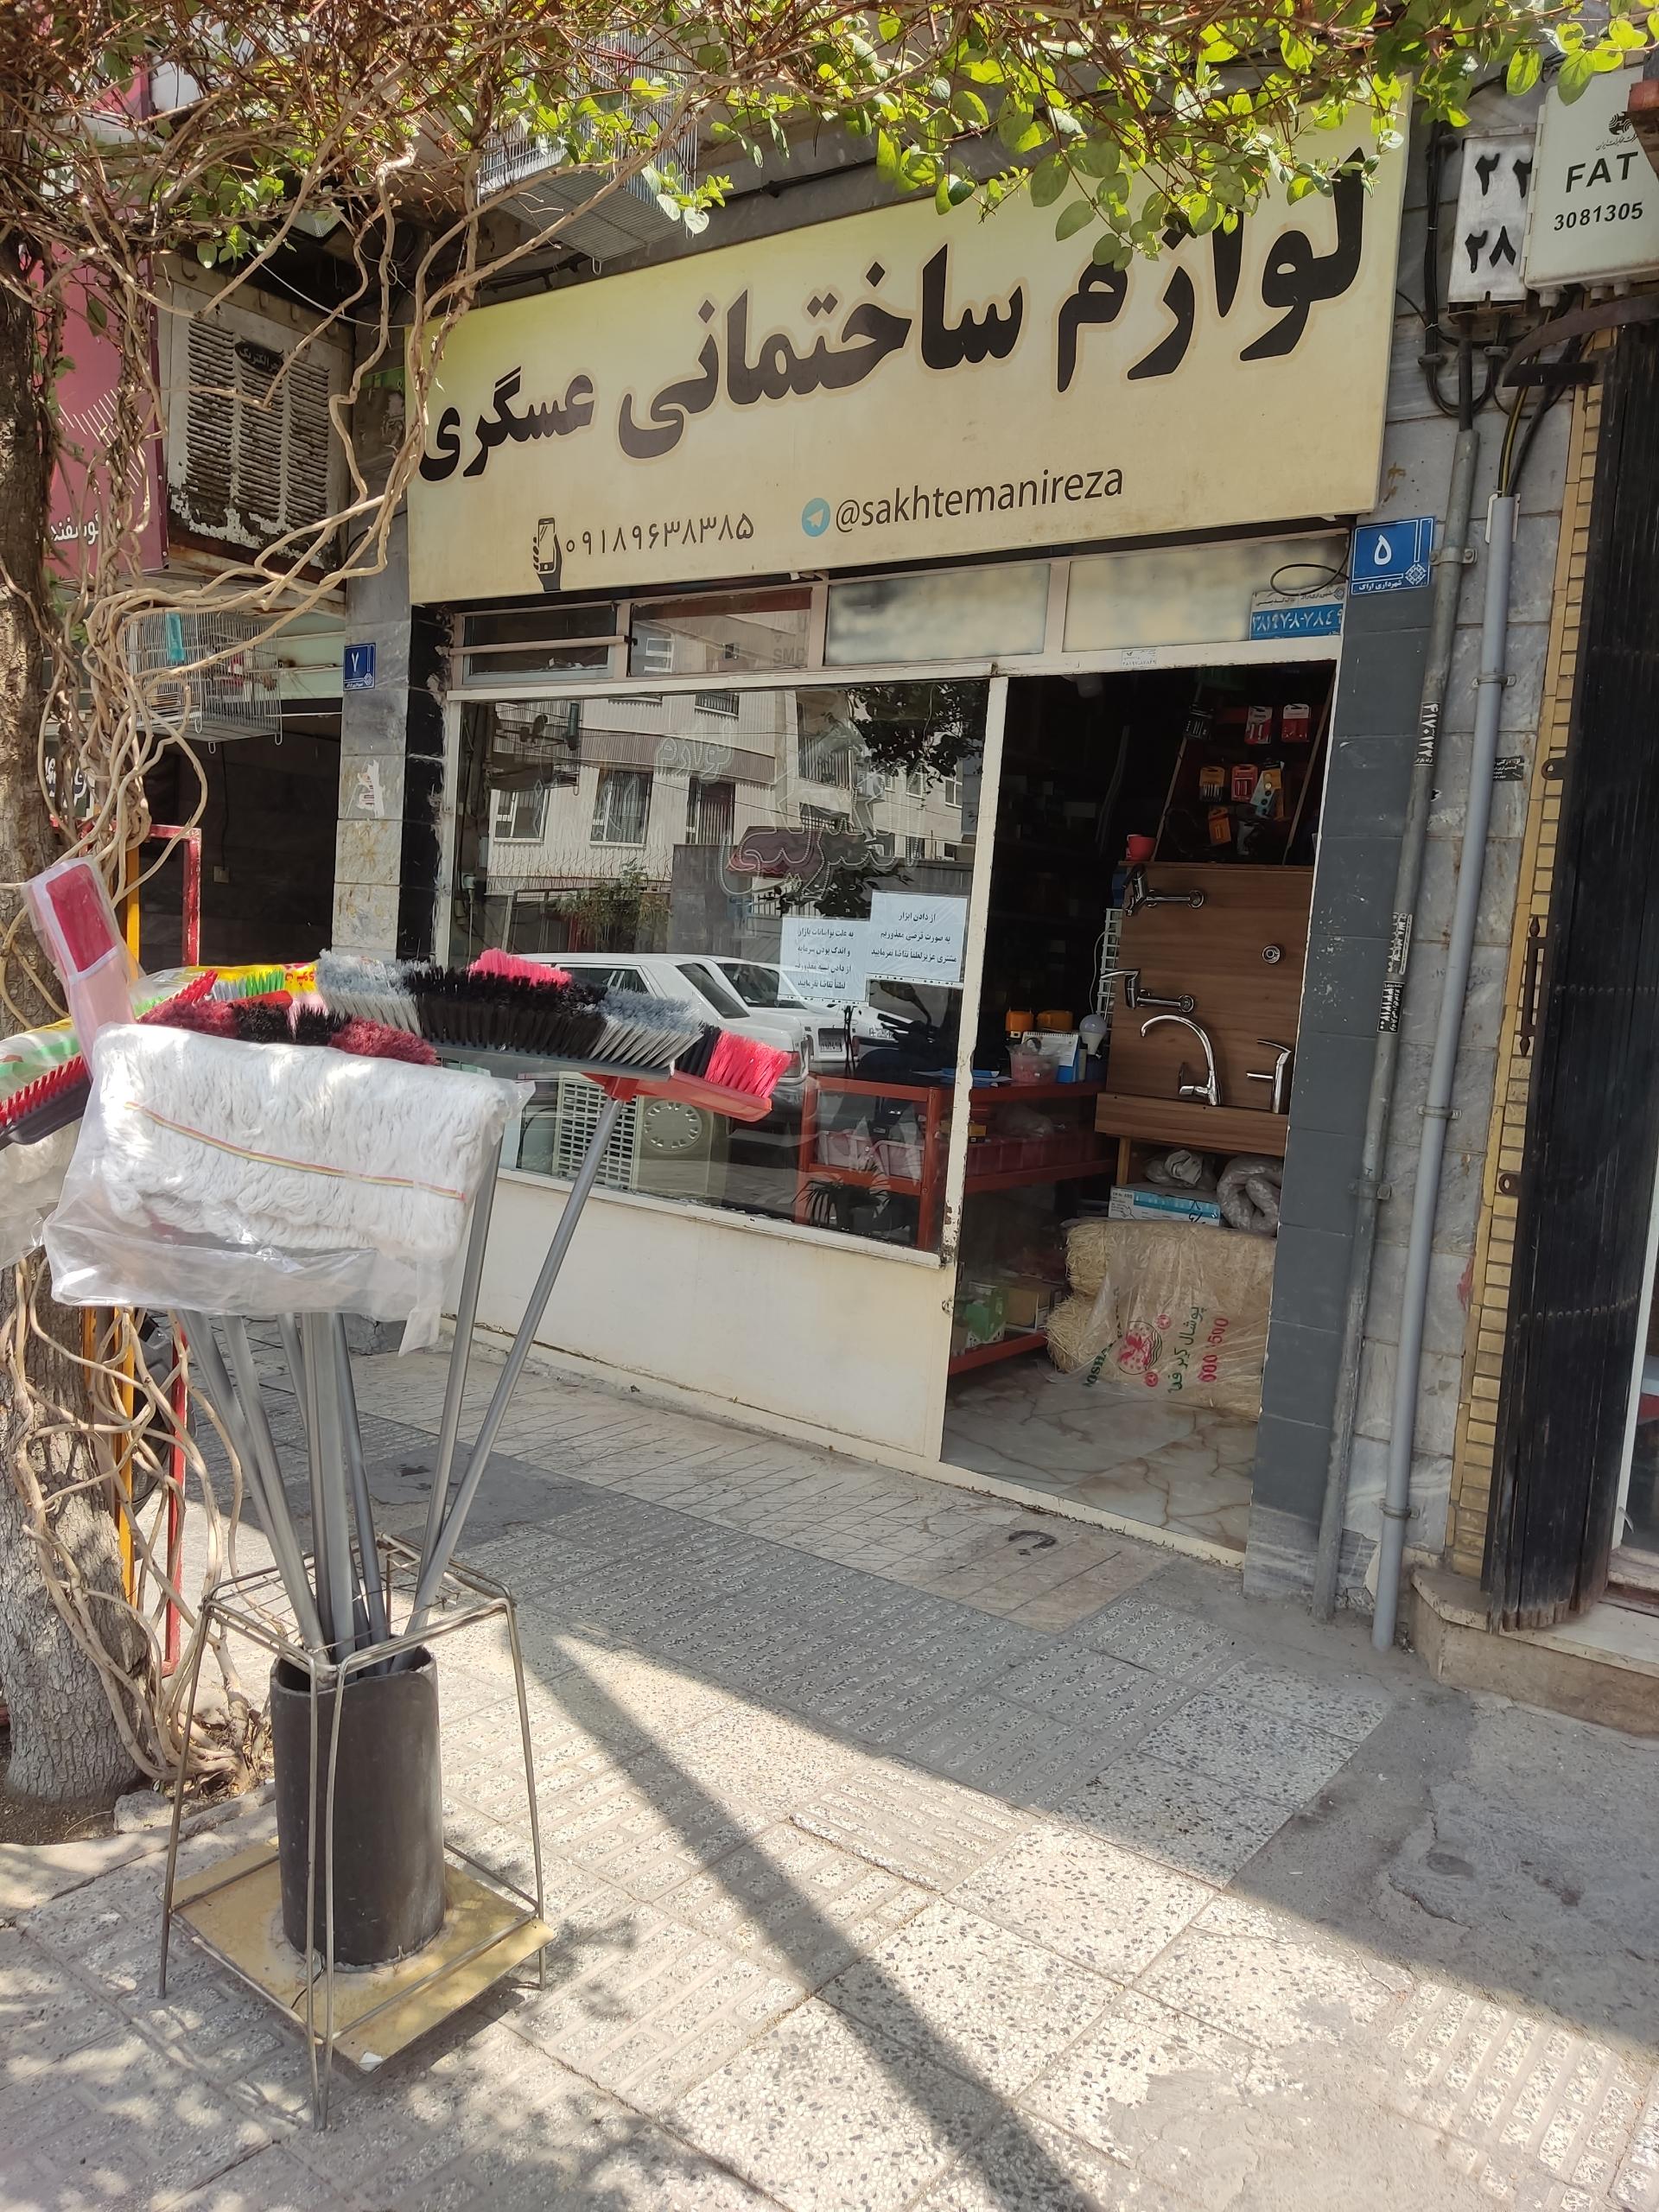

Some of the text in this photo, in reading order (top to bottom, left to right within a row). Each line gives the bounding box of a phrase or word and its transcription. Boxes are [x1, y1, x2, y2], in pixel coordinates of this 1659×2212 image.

[1566, 151, 1639, 194] FAT
[1554, 201, 1643, 232] 3081305
[419, 147, 1365, 481] لوازم ساختمانی عسگری
[836, 467, 1123, 533] @sakhtemanireza
[566, 513, 754, 555] ۰۹۱۸۹۶۳۸۳۸۵
[1374, 534, 1392, 566] ۵
[1358, 579, 1402, 591] شهرداری اراک
[351, 652, 359, 672] ۷
[898, 912, 912, 922] ابزار
[912, 912, 929, 922] دادن
[925, 935, 944, 944] صورت
